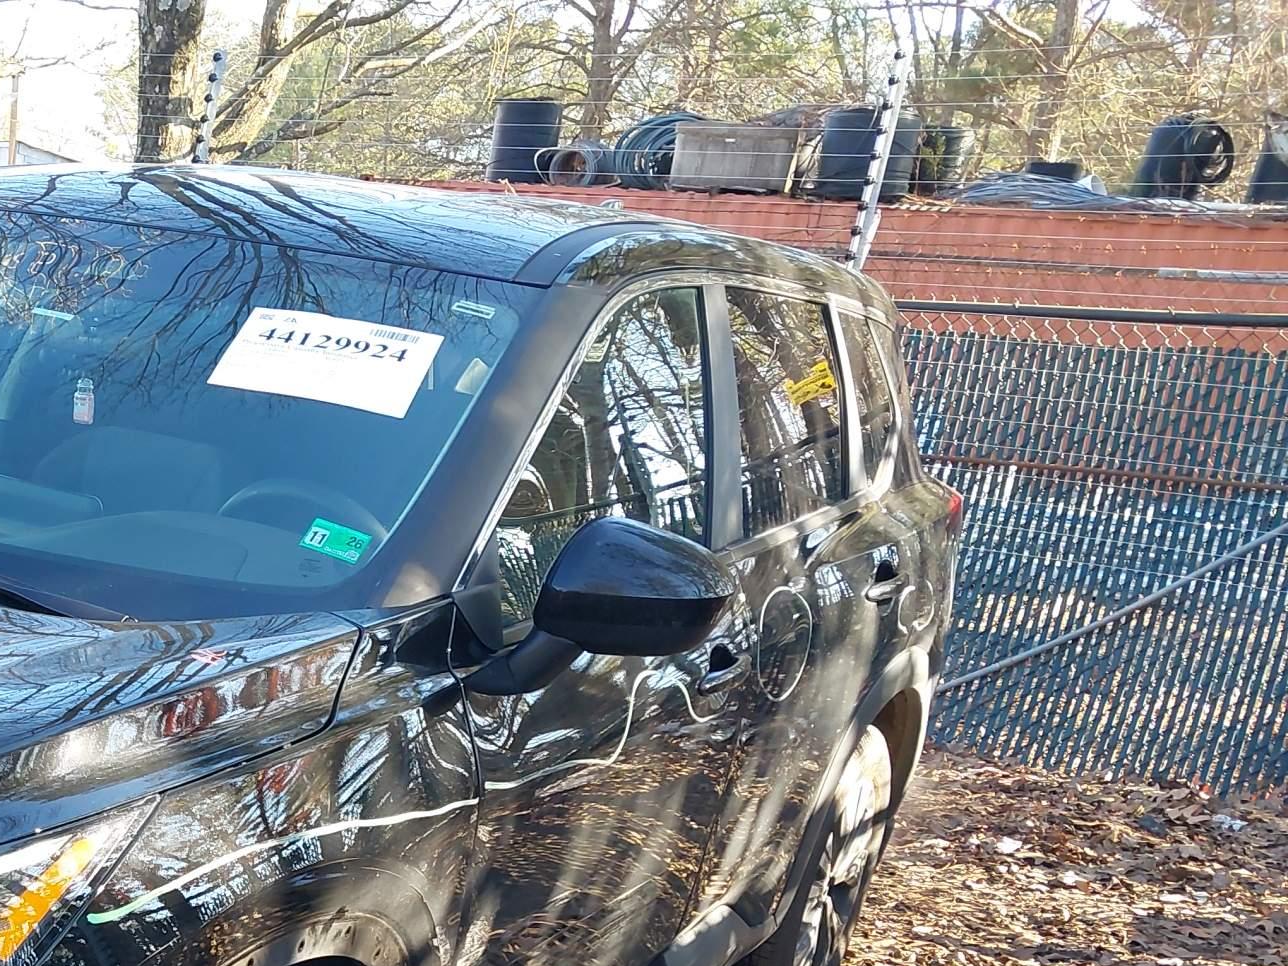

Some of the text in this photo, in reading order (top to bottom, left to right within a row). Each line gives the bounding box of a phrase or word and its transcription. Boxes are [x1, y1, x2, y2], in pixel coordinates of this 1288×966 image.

[258, 327, 408, 362] 44129924
[309, 530, 365, 549] 11 26
